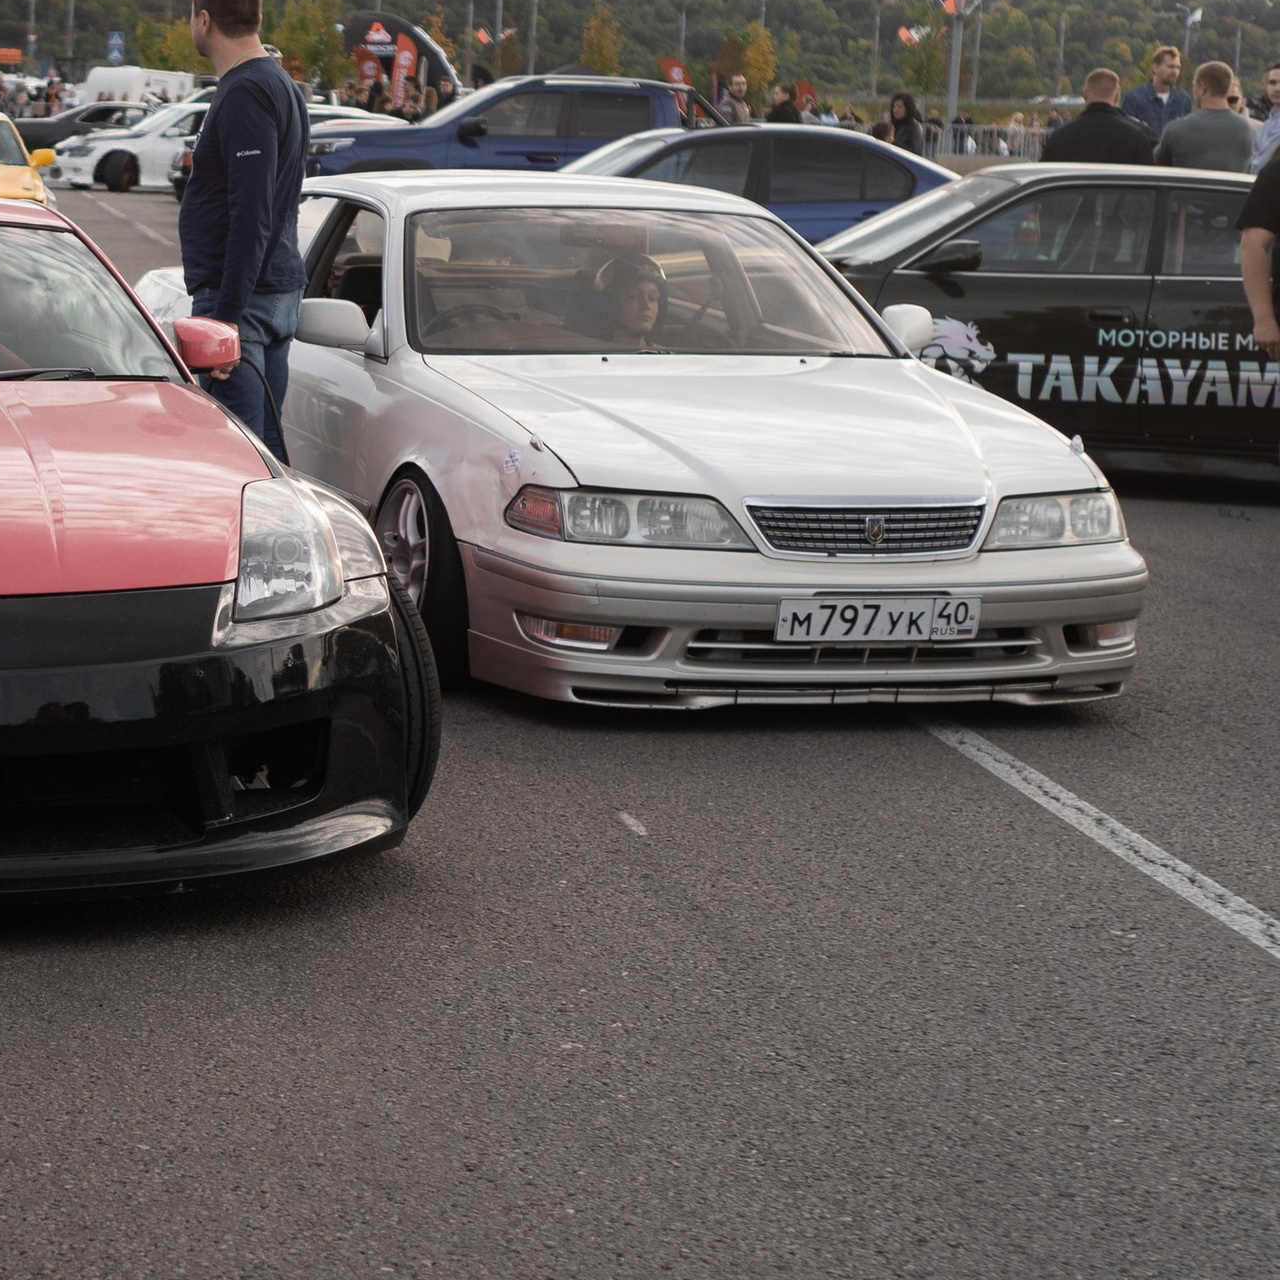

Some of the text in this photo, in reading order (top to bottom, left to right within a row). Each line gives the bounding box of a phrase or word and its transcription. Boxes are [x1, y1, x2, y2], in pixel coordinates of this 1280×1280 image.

[1098, 328, 1260, 351] МОТОРНЫЕ М
[937, 601, 969, 625] 40
[931, 626, 956, 636] RUS
